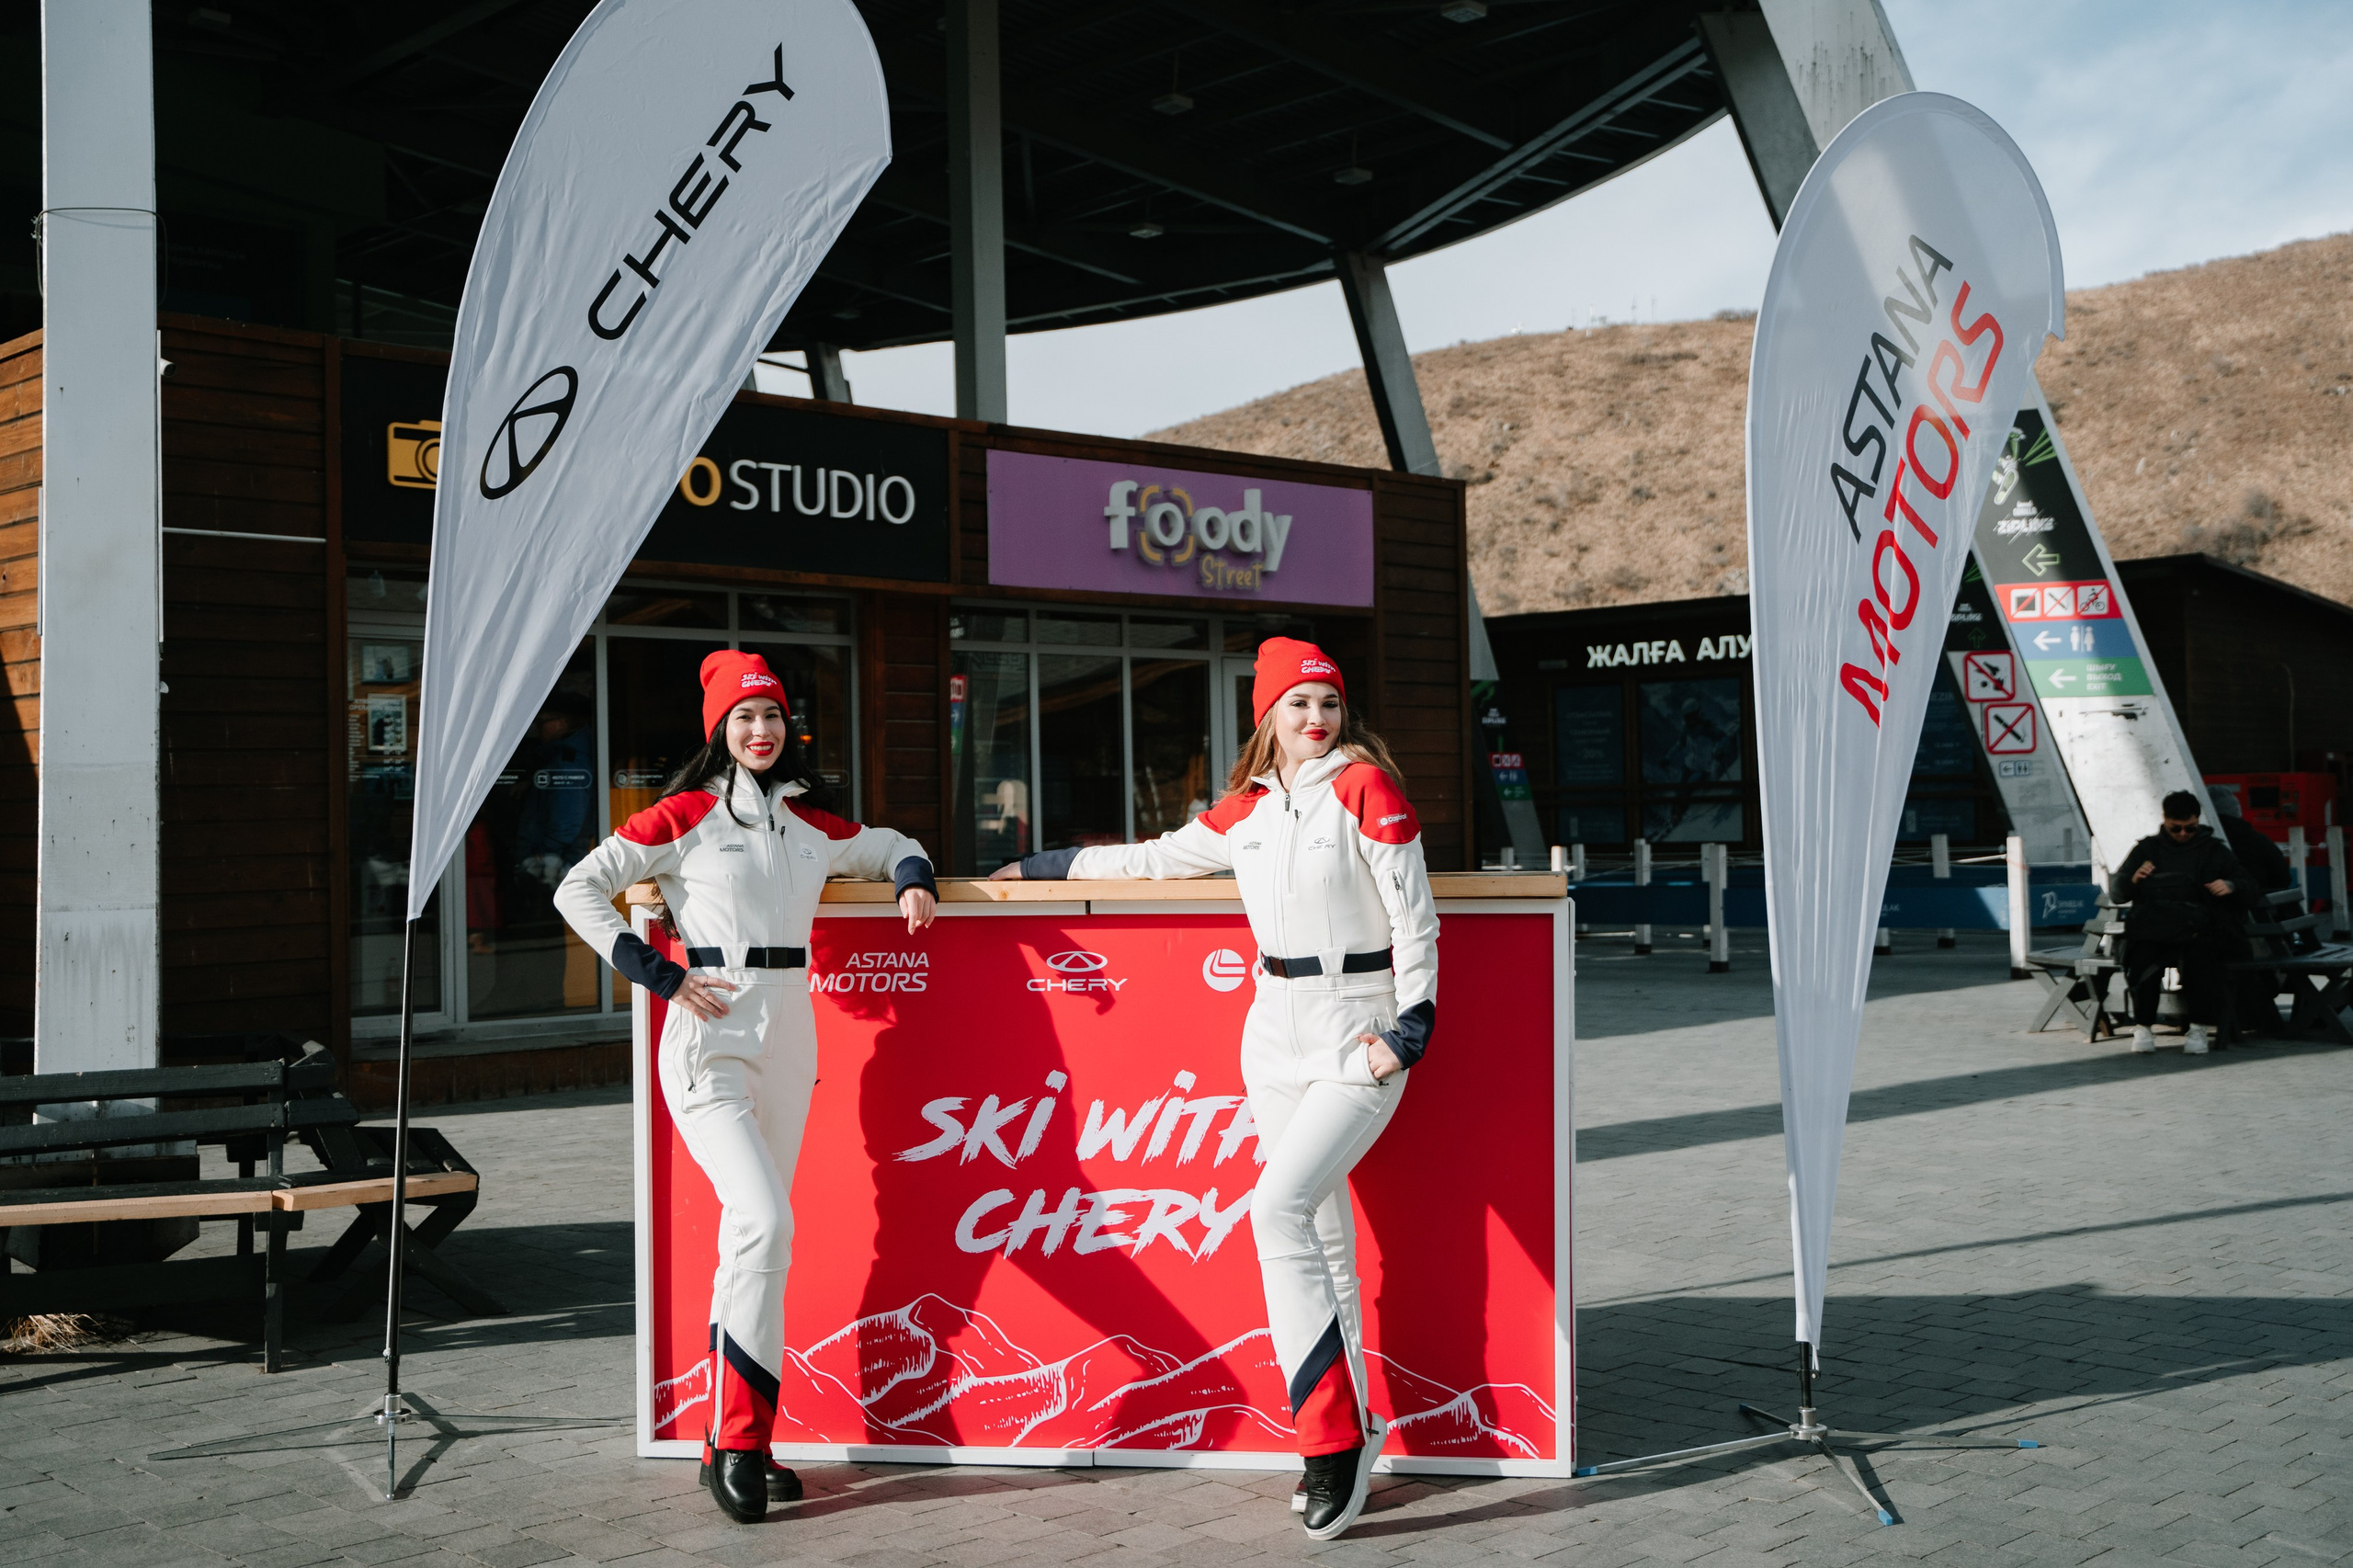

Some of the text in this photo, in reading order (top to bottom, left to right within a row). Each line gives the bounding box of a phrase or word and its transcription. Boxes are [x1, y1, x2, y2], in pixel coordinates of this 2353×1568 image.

[587, 42, 795, 340] CHERY
[1829, 233, 1954, 544] ASTANA
[729, 459, 915, 525] STUDIO
[1840, 279, 2004, 729] MOTORS
[1103, 479, 1292, 572] foody
[1586, 639, 1687, 668] ЖАЛҒА
[2086, 673, 2122, 681] ВЫХОД
[809, 971, 928, 993] MOTORS
[845, 951, 930, 969] ASTANA
[1026, 978, 1129, 992] CHERY
[955, 1187, 1256, 1266] CHERY
